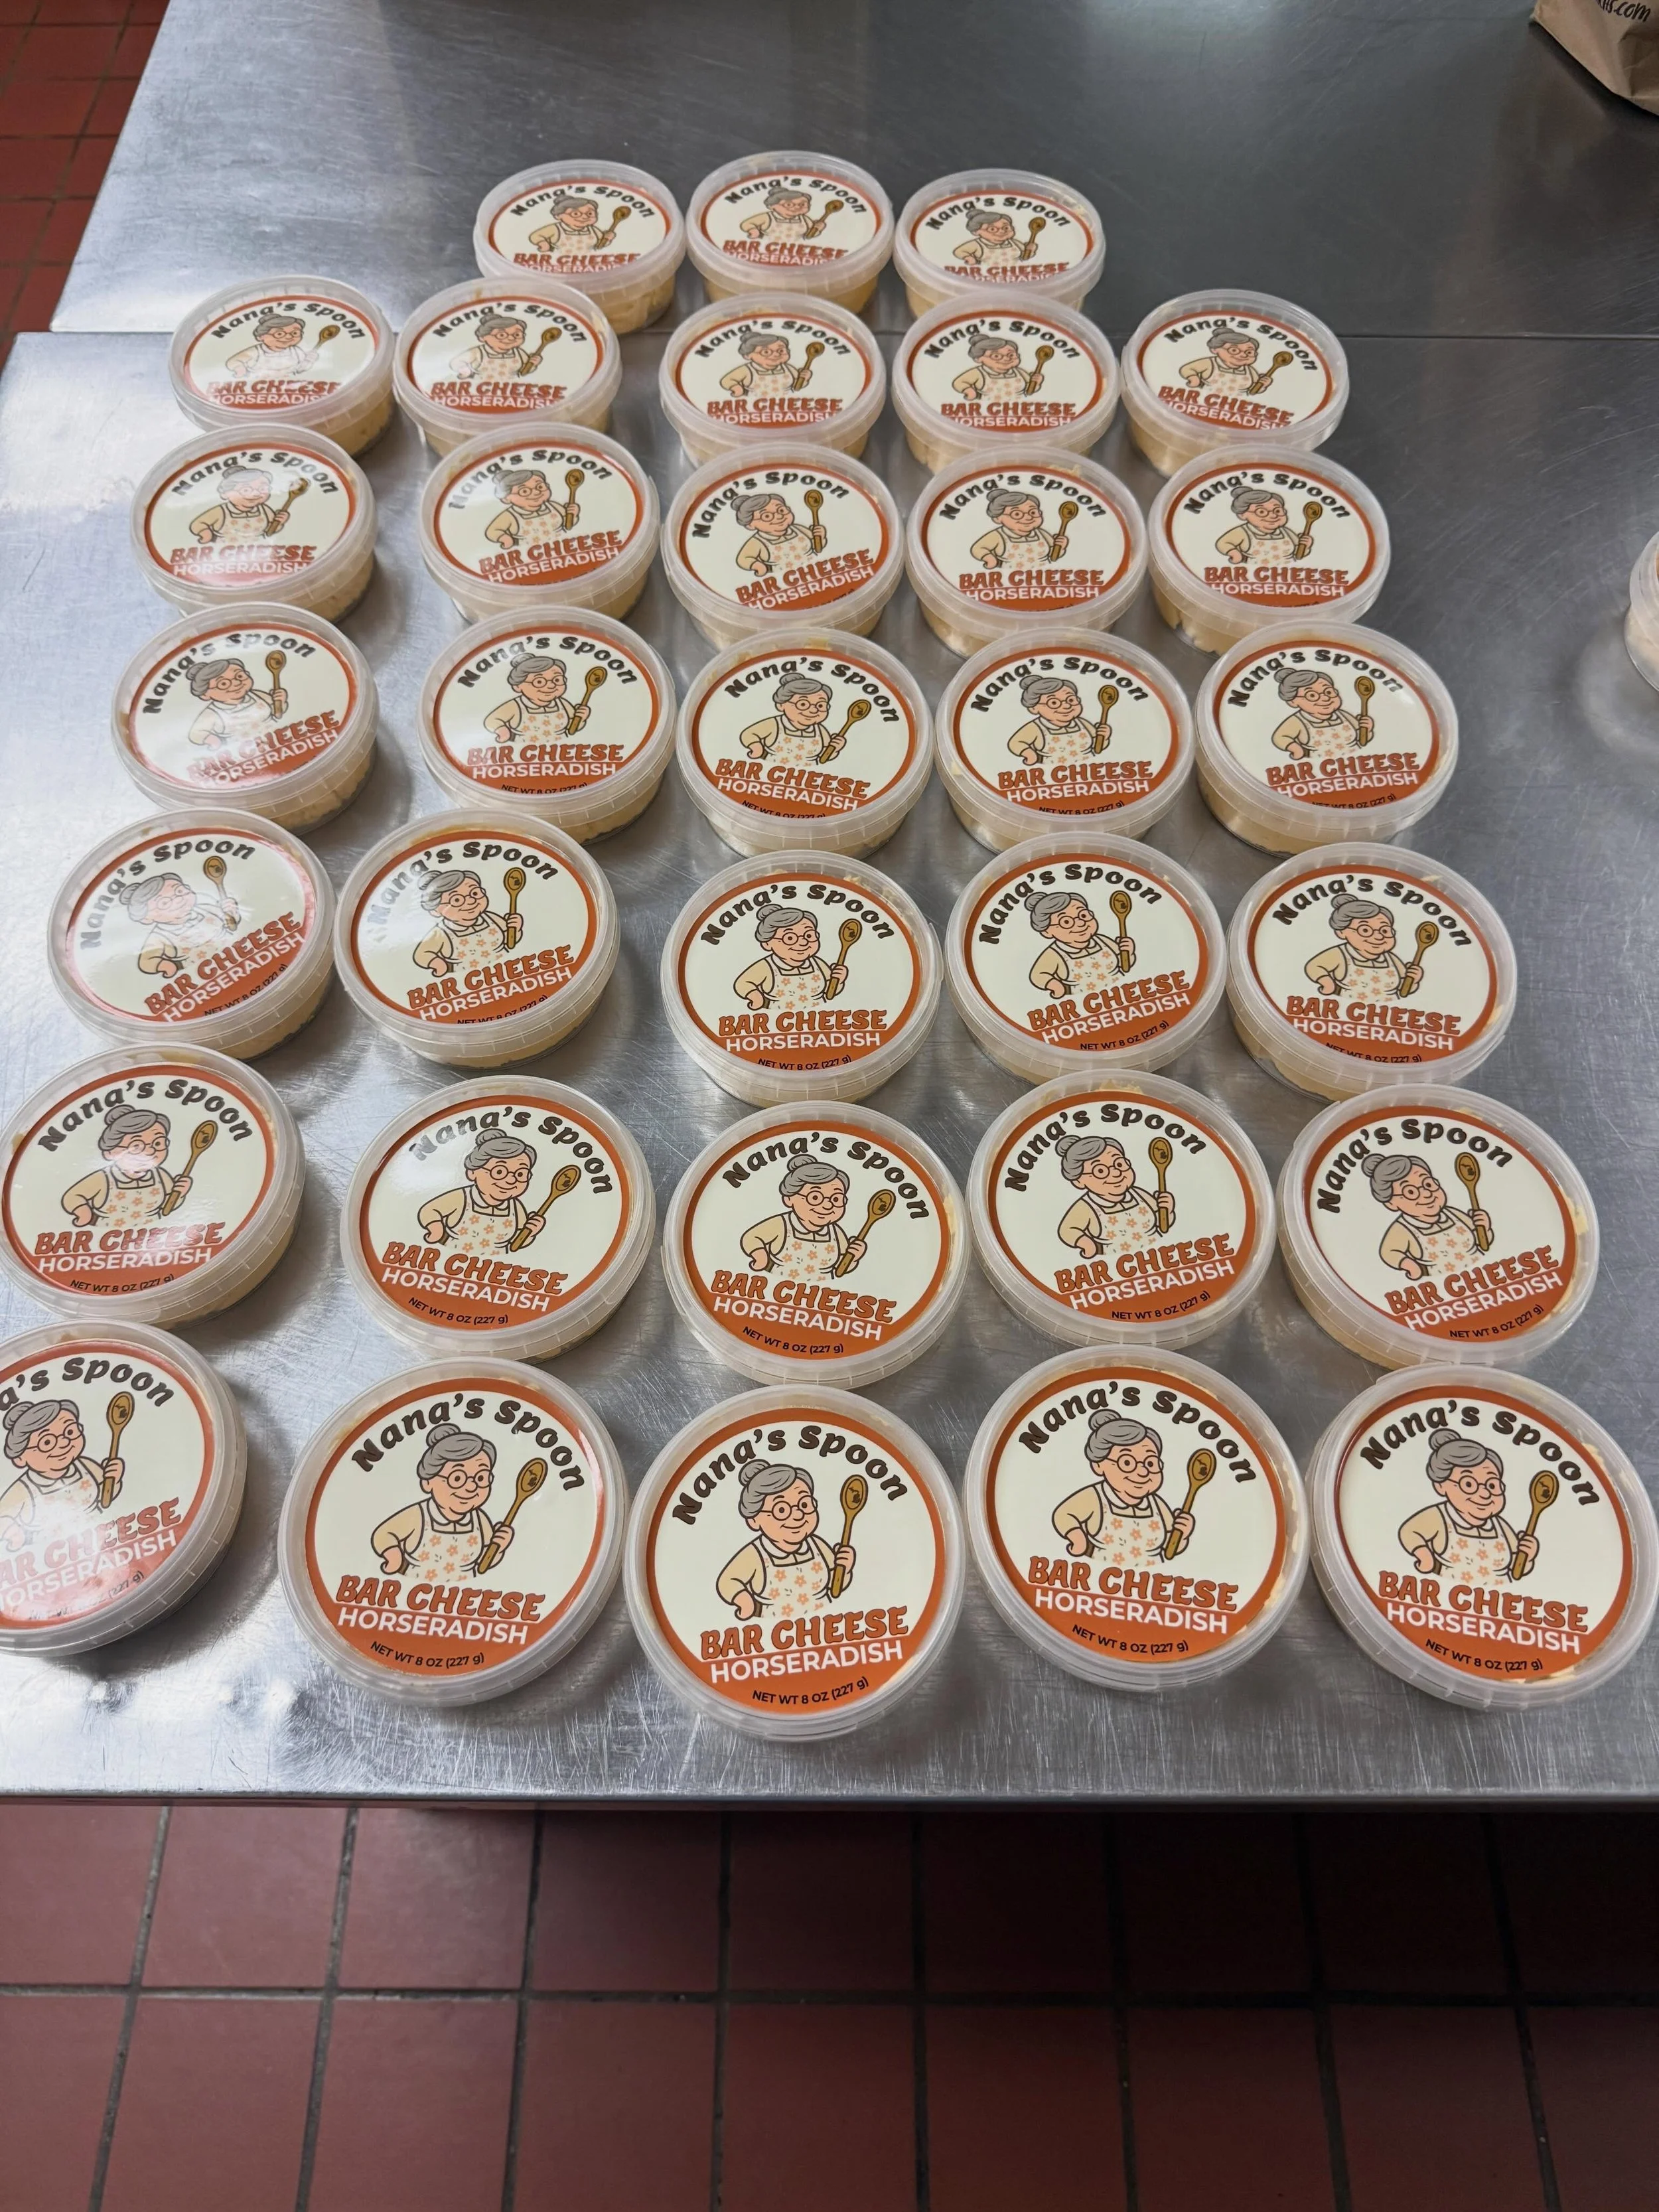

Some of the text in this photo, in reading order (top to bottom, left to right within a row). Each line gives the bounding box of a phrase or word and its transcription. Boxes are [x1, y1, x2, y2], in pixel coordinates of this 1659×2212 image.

[510, 184, 656, 218] Nana's Spoon
[725, 176, 868, 212] Nana's Spoon
[925, 196, 1071, 232] Nana's Spoon
[513, 254, 552, 265] BAR
[721, 239, 760, 252] BAR
[211, 301, 366, 338] Nana's Spoon
[433, 301, 587, 341] Nana's Spoon
[695, 319, 851, 357] Nana's Spoon
[924, 320, 1080, 358] Nana's Spoon
[1165, 316, 1319, 369] Nana's Spoon
[429, 380, 569, 398] BAR CHEESE
[705, 398, 844, 413] BAR CHEESE
[940, 402, 1077, 416] BAR CHEESE
[1157, 384, 1297, 424] BAR CHEESE
[532, 448, 611, 479] Spoon
[691, 471, 849, 537] Nana's Spoon
[940, 473, 1106, 519] Nana's Spoon
[1185, 471, 1350, 518] Nana's Spoon
[478, 529, 624, 573] BAR CHEESE
[734, 577, 782, 603] BAR
[782, 547, 875, 587] CHEESE
[958, 569, 1106, 589] BAR CHEESE
[1204, 566, 1350, 584] BAR CHEESE
[458, 634, 637, 687] Nana's Spoon
[972, 656, 1148, 711] Nana's Spoon
[1230, 648, 1404, 705] Nana's Spoon
[725, 655, 899, 720] Nana's Spoon
[466, 743, 625, 765] BAR CHEESE
[472, 763, 617, 778] HORSERADISH
[997, 759, 1154, 789] BAR CHEESE
[1265, 751, 1422, 784] BAR CHEESE
[714, 758, 872, 798] BAR CHEESE
[717, 778, 859, 811] HORSERADISH
[1006, 779, 1150, 802] HORSERADISH
[701, 883, 894, 945] Nana's Spoon
[979, 863, 1162, 944] Nana's Spoon
[1273, 873, 1473, 946] Nana's Spoon
[143, 910, 302, 1015] BAR CHEESE
[163, 931, 305, 1023] HORSERADISH
[406, 944, 575, 1009] BAR CHEESE
[419, 966, 573, 1022] HORSERADISH
[1026, 969, 1191, 1031] BAR CHEESE
[1286, 995, 1462, 1035] BAR CHEESE
[718, 1009, 889, 1035] BAR CHEESE
[725, 1031, 882, 1051] HORSERADISH
[1041, 992, 1191, 1045] HORSERADISH
[1293, 1019, 1455, 1050] HORSERADISH
[36, 1080, 253, 1153] Nana's Spoon
[407, 1106, 613, 1195] Nana's Spoon
[1005, 1104, 1206, 1192] Nana's Spoon
[1317, 1120, 1513, 1216] Nana's Spoon
[723, 1132, 929, 1218] Nana's Spoon
[33, 1224, 226, 1256] BAR CHEESE
[39, 1249, 212, 1274] HORSERADISH
[1054, 1232, 1236, 1294] BAR CHEESE
[380, 1241, 569, 1296] BAR CHEESE
[382, 1268, 550, 1313] HORSERADISH
[1070, 1259, 1236, 1310] HORSERADISH
[1385, 1246, 1560, 1317] BAR CHEESE
[709, 1270, 898, 1323] BAR CHEESE
[713, 1297, 883, 1341] HORSERADISH
[1112, 1311, 1133, 1320] NET
[1134, 1311, 1153, 1320] WT
[1164, 1305, 1181, 1315] OZ
[1180, 1295, 1199, 1312] (227
[1200, 1290, 1212, 1301] g)
[1405, 1273, 1563, 1331] HORSERADISH
[61, 1357, 174, 1407] Spoon
[351, 1393, 587, 1493] Nana's Spoon
[1019, 1380, 1256, 1483] Nana's Spoon
[1360, 1400, 1600, 1507] Nana's Spoon
[672, 1425, 908, 1526] Nana's Spoon
[335, 1576, 546, 1623] BAR CHEESE
[1027, 1556, 1239, 1613] BAR CHEESE
[1378, 1572, 1589, 1634] BAR CHEESE
[339, 1610, 528, 1645] HORSERADISH
[700, 1605, 909, 1660] BAR CHEESE
[1035, 1591, 1228, 1635] HORSERADISH
[1388, 1605, 1579, 1655] HORSERADISH
[371, 1641, 484, 1669] NET WT 8 OZ (227 g)
[711, 1640, 902, 1684] HORSERADISH
[752, 1676, 869, 1705] NET WT 8 OZ (227 g)
